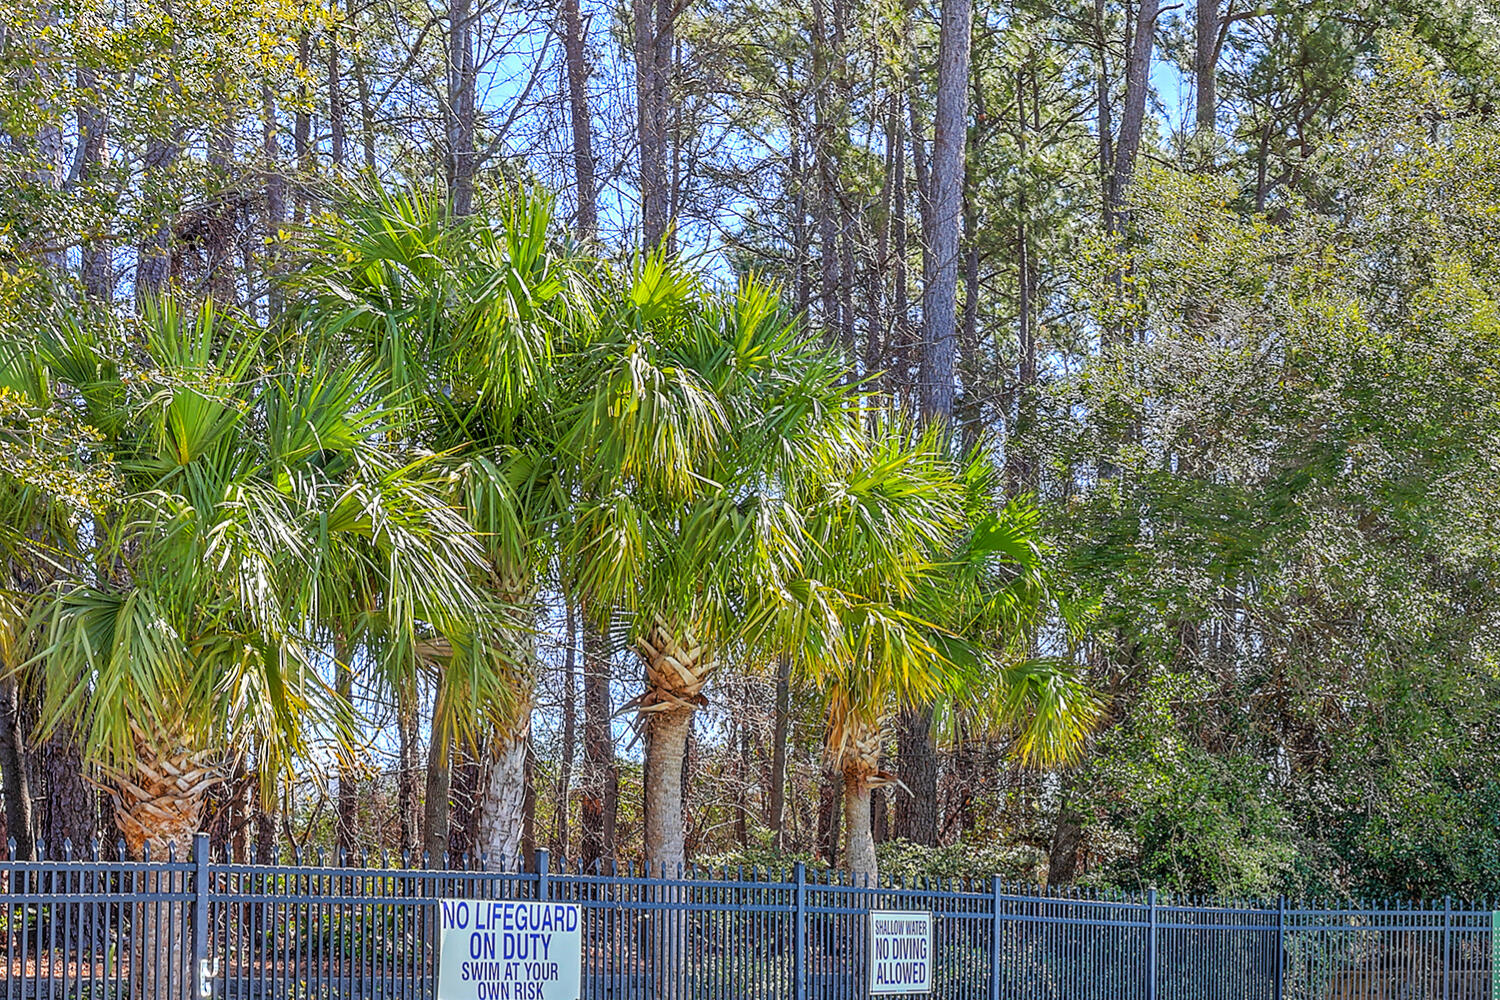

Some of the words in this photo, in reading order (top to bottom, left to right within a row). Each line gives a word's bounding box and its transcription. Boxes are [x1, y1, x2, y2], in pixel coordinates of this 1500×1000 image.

[443, 901, 469, 930] NO
[475, 902, 577, 932] LIFEGUARD
[875, 919, 904, 935] SHALLOW
[905, 920, 927, 935] WATER
[470, 932, 495, 960] ON
[503, 932, 552, 960] DUTY
[876, 937, 889, 960] NO
[892, 938, 927, 960] DIVING
[462, 961, 500, 981] SWIM
[504, 962, 520, 981] AT
[524, 962, 558, 981] YOUR
[876, 962, 926, 985] ALLOWED
[478, 981, 510, 1000] OWN
[514, 981, 544, 1000] RISK
